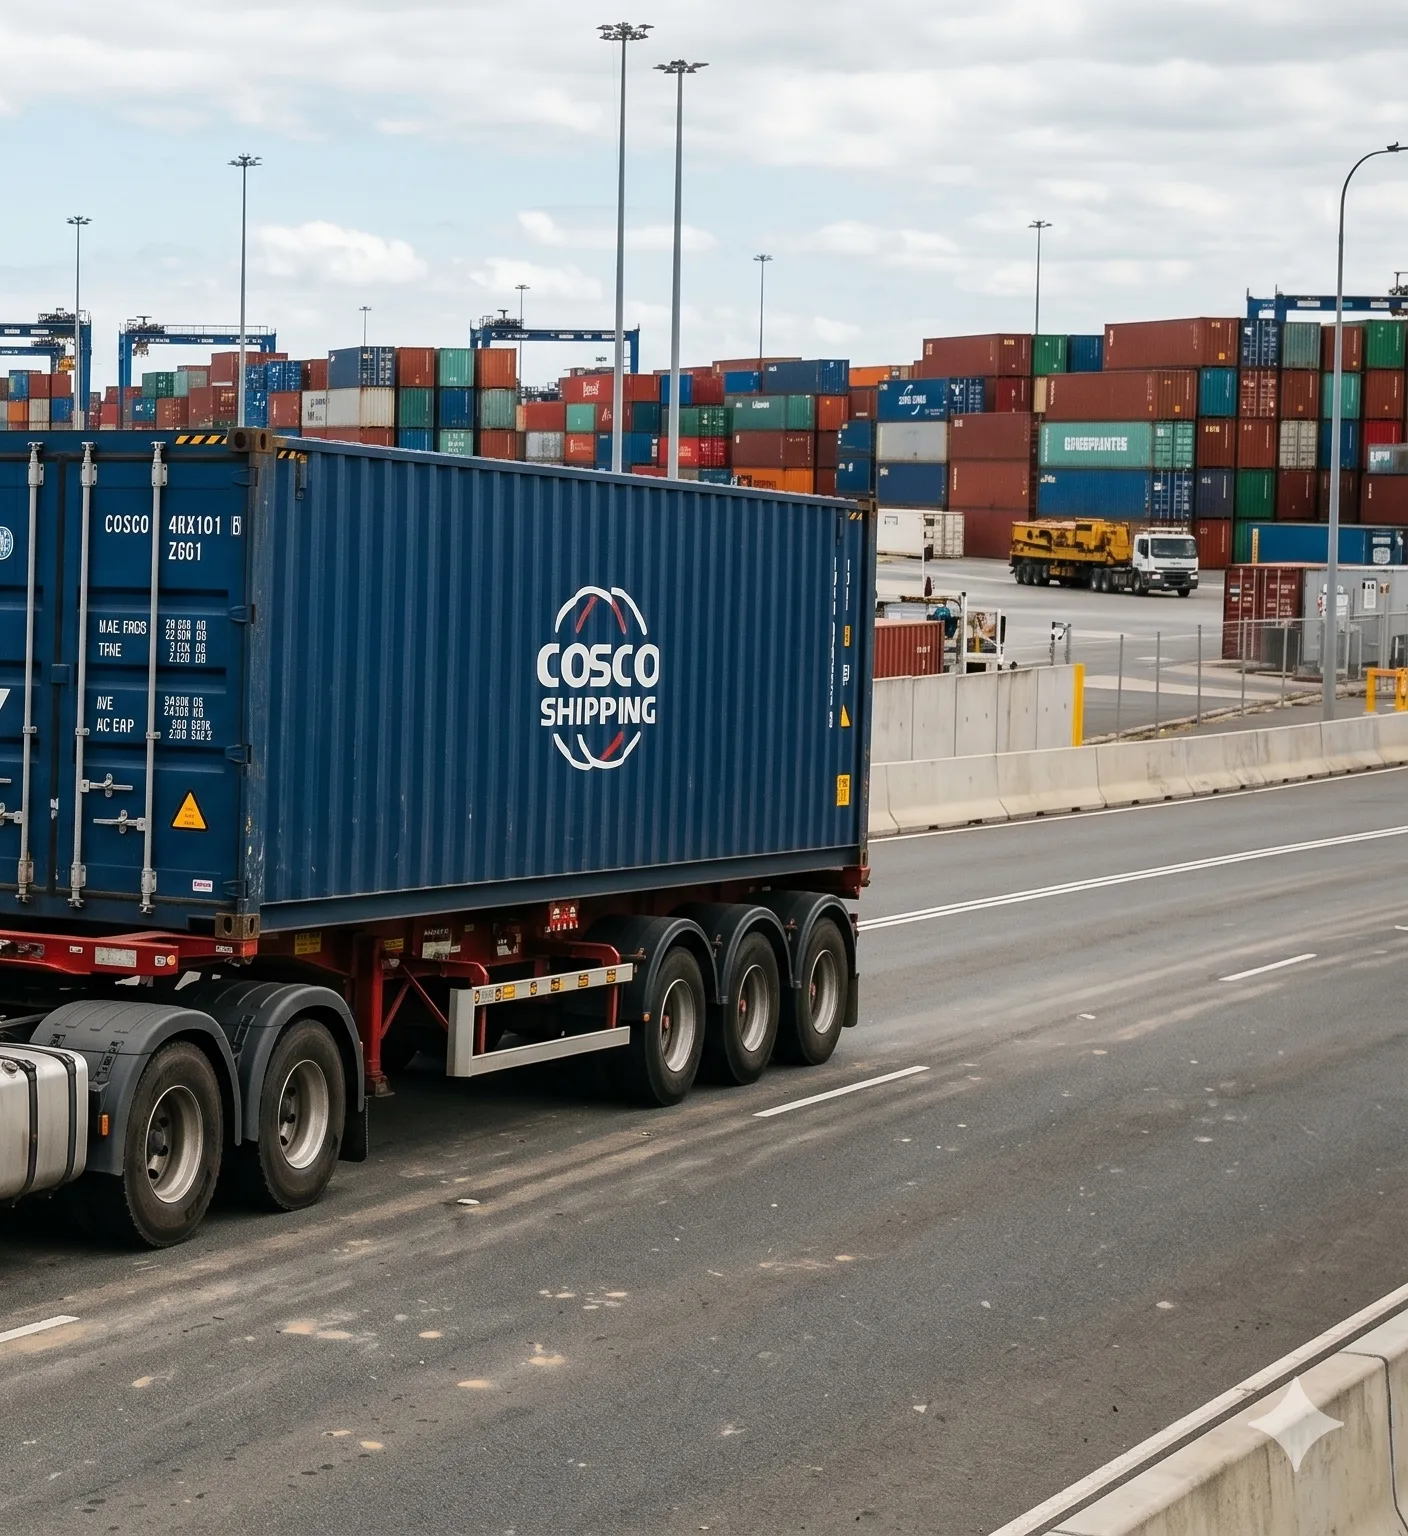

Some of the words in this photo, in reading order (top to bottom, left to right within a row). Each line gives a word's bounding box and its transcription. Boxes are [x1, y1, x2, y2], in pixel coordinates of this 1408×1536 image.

[105, 514, 149, 534] COSCO
[536, 642, 660, 688] COSCO
[540, 696, 656, 727] SHIPPING
